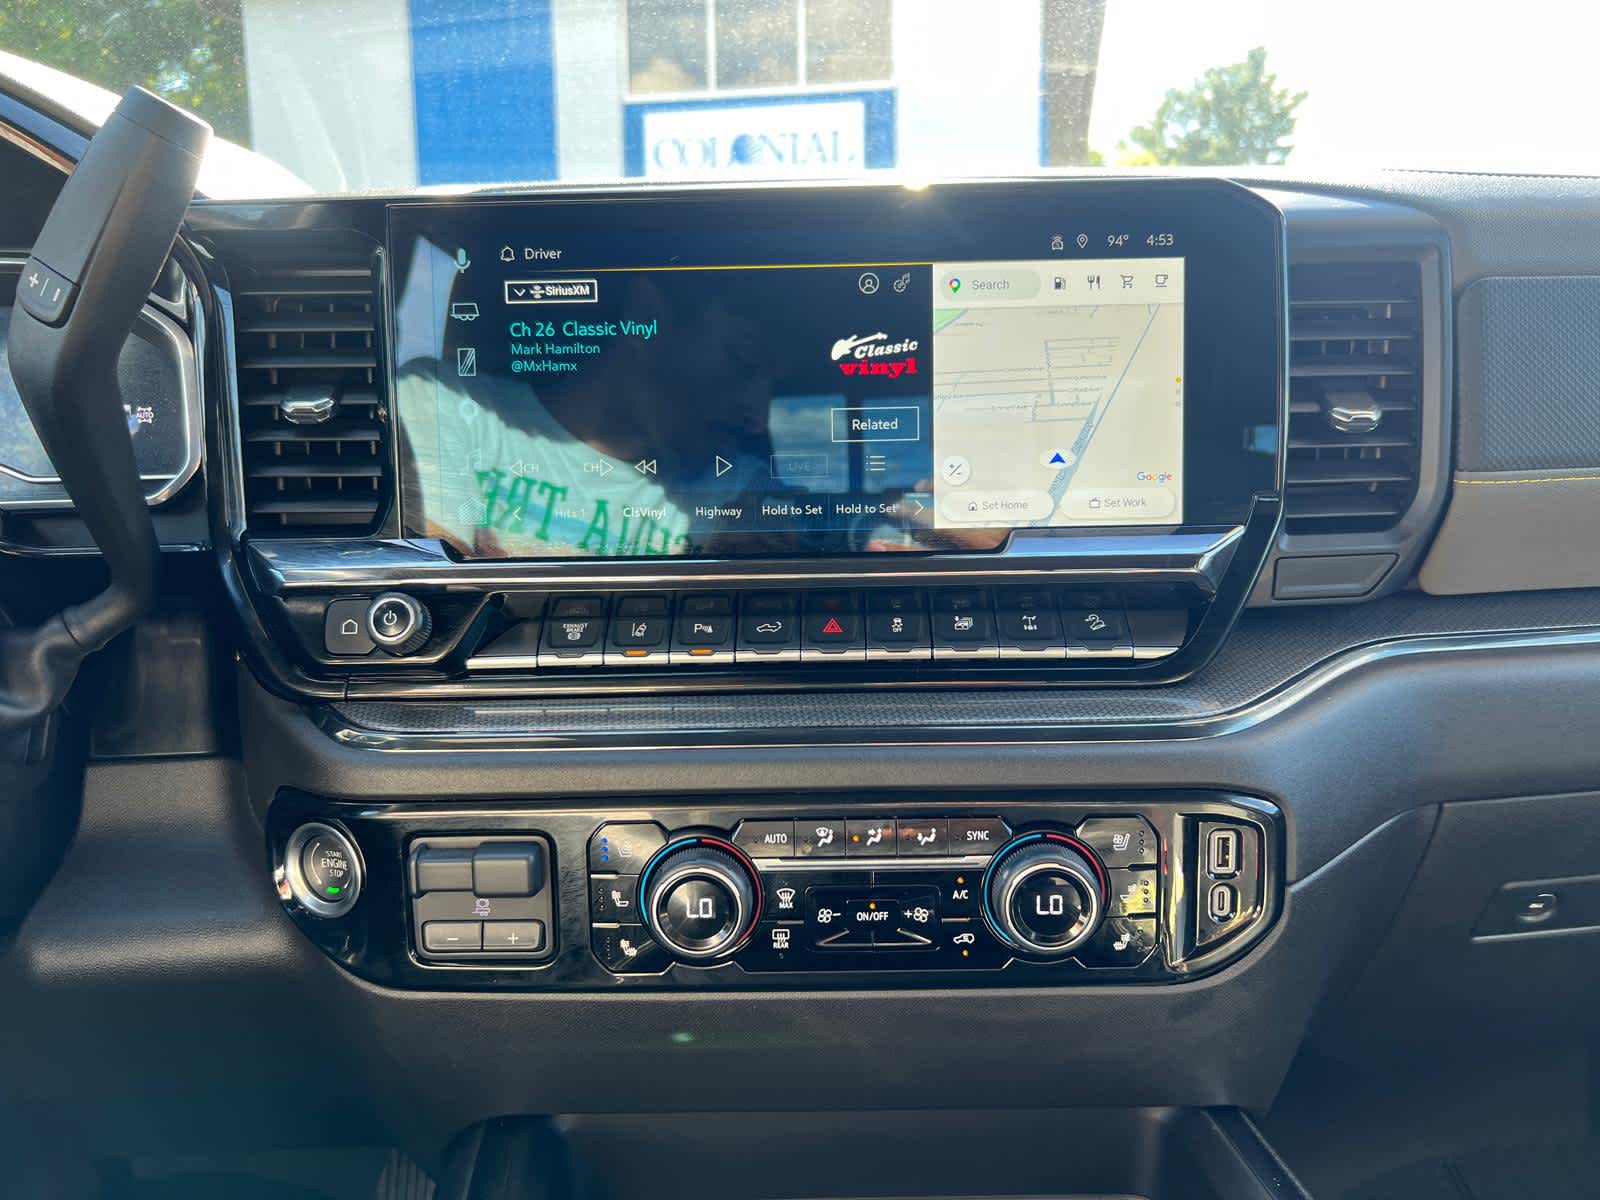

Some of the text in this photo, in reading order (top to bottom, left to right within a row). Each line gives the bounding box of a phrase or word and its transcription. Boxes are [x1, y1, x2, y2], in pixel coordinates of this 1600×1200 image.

[1146, 234, 1174, 246] 4:53
[525, 248, 562, 260] Driver
[545, 285, 590, 296] SiriusXM
[971, 279, 1010, 290] Search
[510, 320, 657, 339] Ch 26 Classic Vinyl
[511, 342, 600, 355] Mark Hamilton
[854, 338, 918, 359] Classic
[511, 360, 577, 372] @MxHamx
[839, 357, 918, 378] vinyl
[852, 418, 898, 430] Related
[1137, 471, 1173, 484] Google
[836, 503, 897, 514] Hold to Set
[982, 500, 1029, 510] Set Home
[1104, 497, 1147, 508] Set Work
[695, 506, 742, 518] Highway
[762, 504, 823, 516] Hold to Set
[764, 833, 788, 844] AUTO
[966, 830, 990, 841] SYNC
[321, 857, 348, 871] ENGINE
[329, 869, 343, 878] STOP
[952, 889, 969, 900] A/C
[856, 911, 889, 921] ON/OFF
